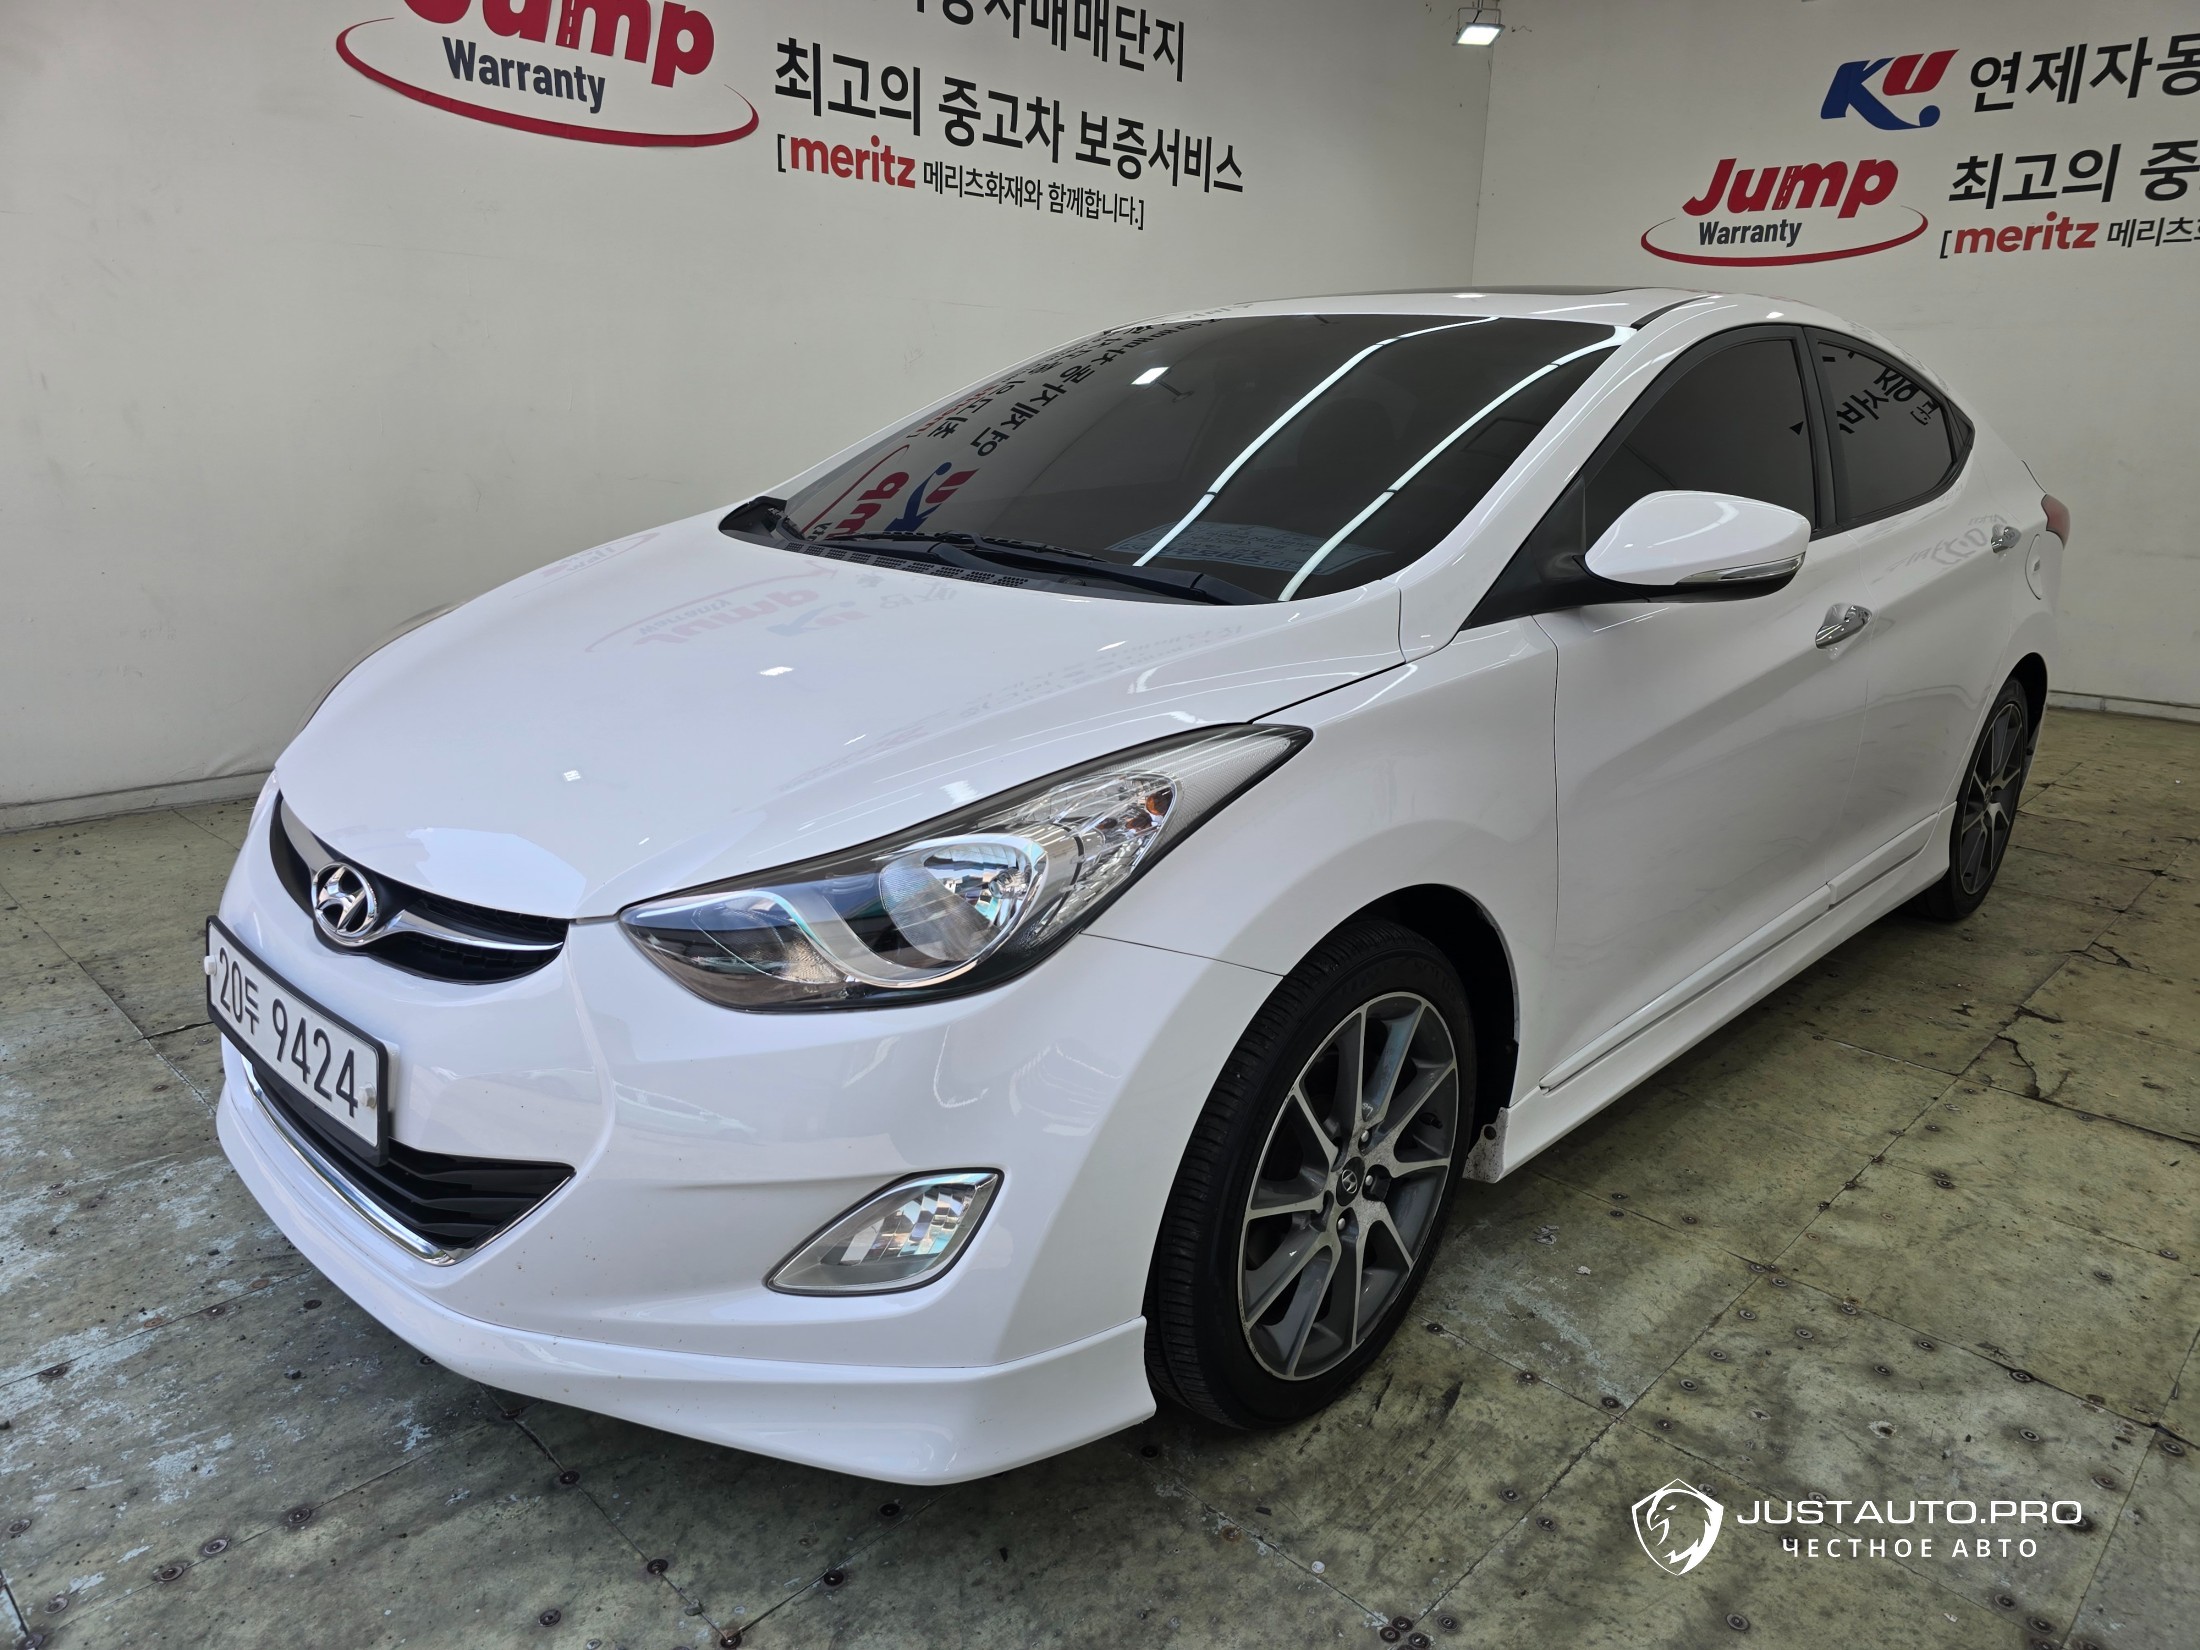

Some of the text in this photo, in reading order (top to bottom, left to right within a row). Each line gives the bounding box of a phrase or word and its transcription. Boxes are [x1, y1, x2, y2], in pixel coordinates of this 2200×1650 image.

[442, 36, 606, 115] Warranty
[1969, 33, 2200, 113] 연제자동
[774, 37, 1244, 193] 최고의 중고차 보증서비스
[922, 160, 1043, 210] 메리츠화재와
[1048, 183, 1145, 230] 함께합니다.]
[1682, 158, 1899, 219] Jump
[1949, 143, 2122, 210] 최고의
[1699, 219, 1802, 247] Warranty
[2106, 217, 2200, 248] 메리츠
[218, 946, 359, 1118] 20두 9424
